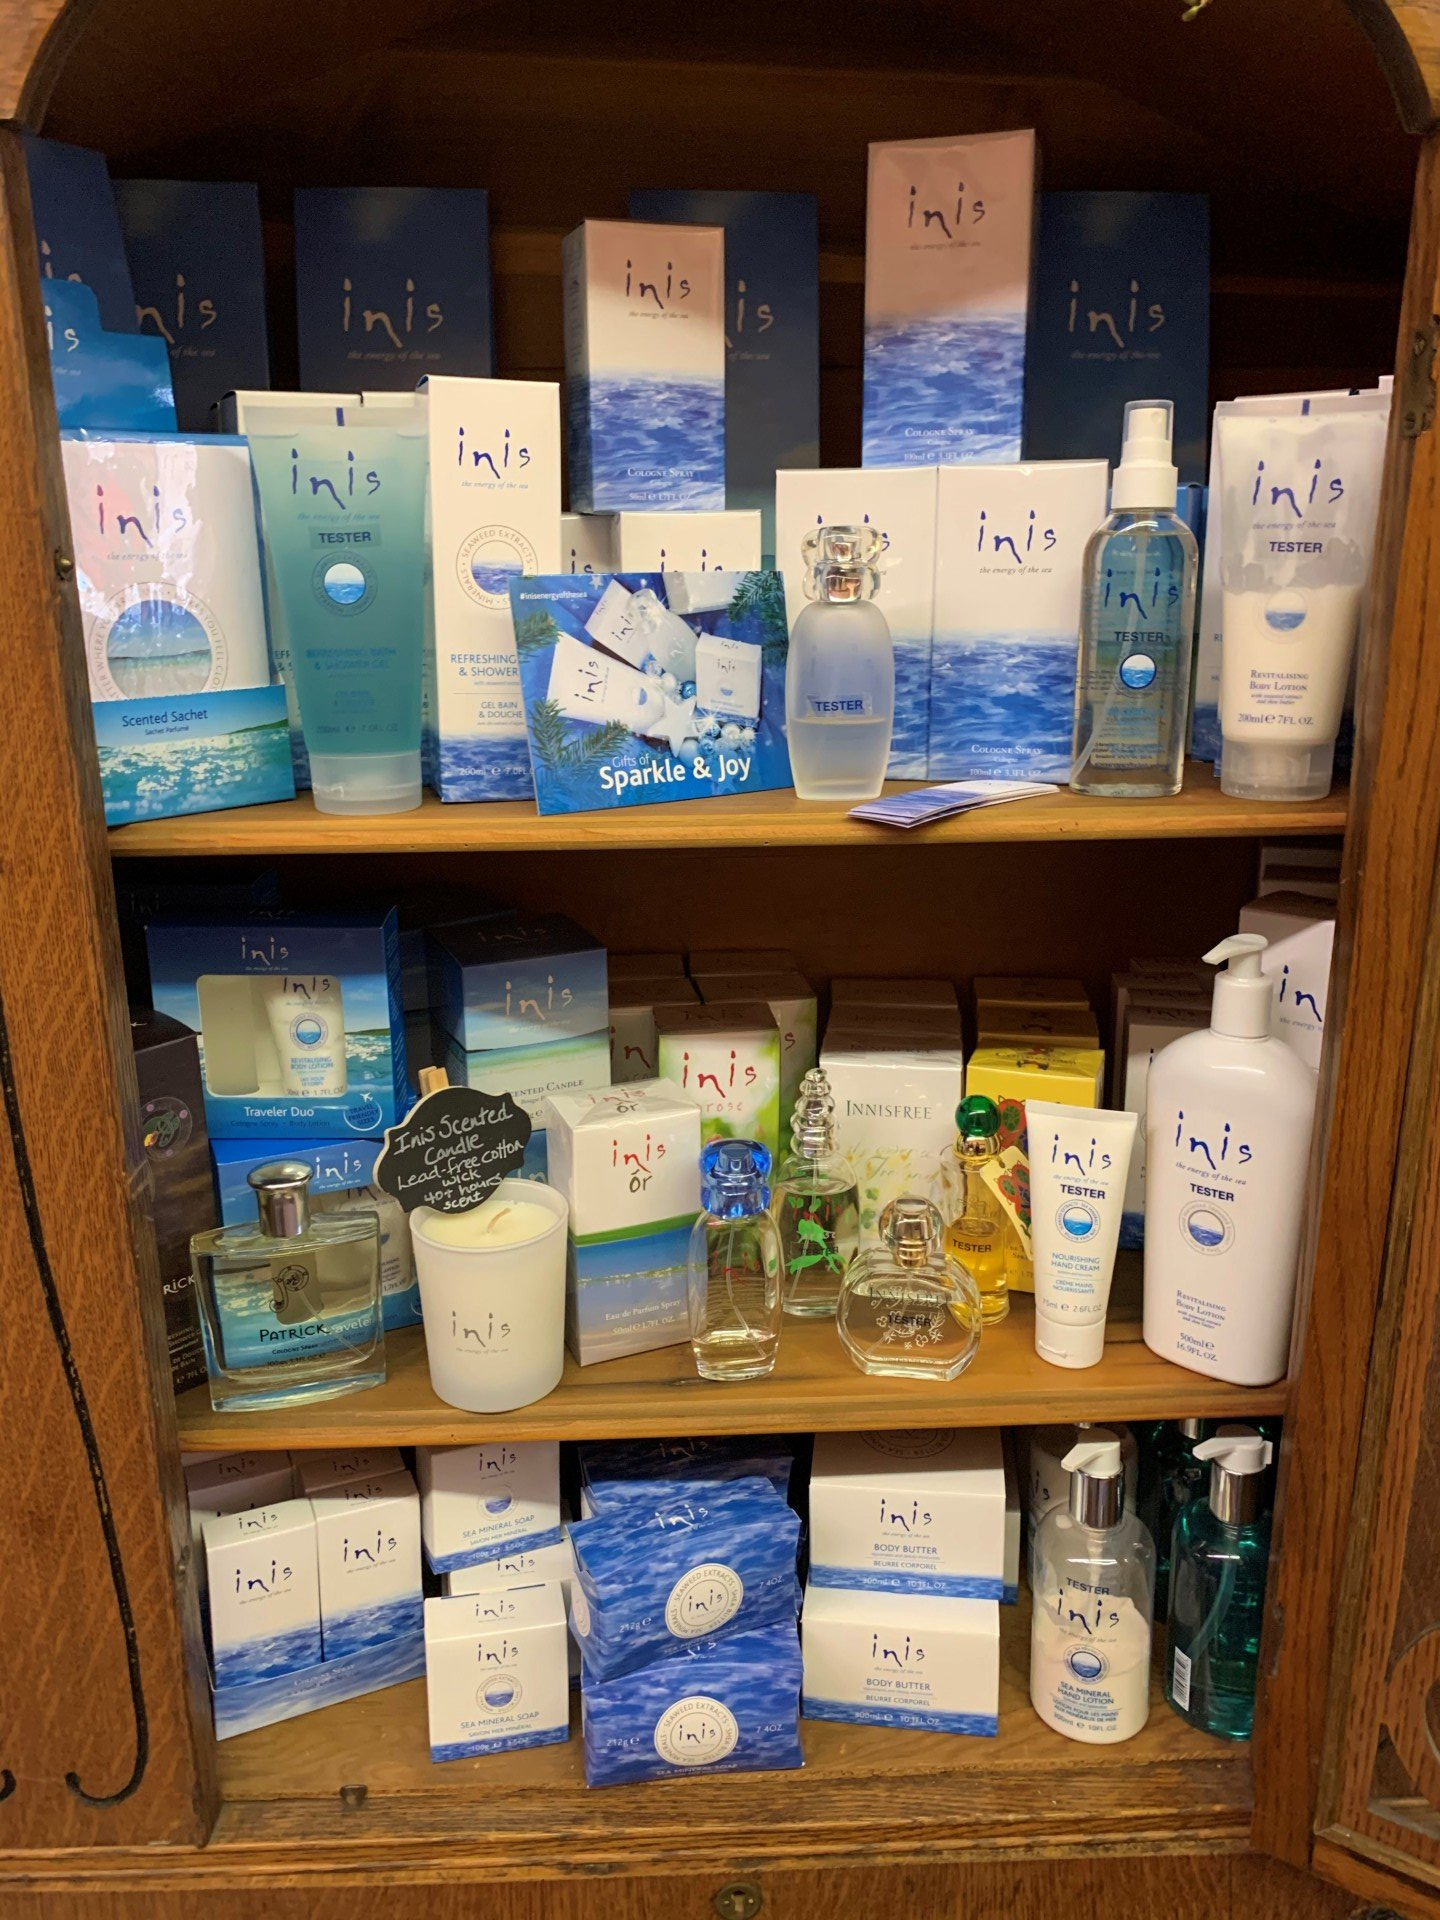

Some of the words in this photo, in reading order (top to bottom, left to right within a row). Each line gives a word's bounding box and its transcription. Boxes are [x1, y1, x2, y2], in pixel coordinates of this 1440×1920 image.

[908, 182, 985, 239] inis
[625, 259, 691, 309] inis
[343, 277, 443, 347] inis
[1067, 279, 1165, 349] inis
[458, 427, 531, 479] inis
[291, 448, 380, 510] inis
[1252, 459, 1344, 518] inis
[96, 484, 188, 549] inis
[1252, 520, 1265, 530] the
[1266, 521, 1294, 531] energy
[1297, 520, 1305, 530] of
[1307, 520, 1322, 529] the
[1323, 521, 1337, 529] sea
[318, 531, 371, 543] TESTER
[978, 509, 1056, 564] inis
[1269, 541, 1323, 553] TESTER
[980, 566, 991, 574] the
[992, 567, 1015, 575] energy
[1018, 565, 1026, 575] of
[1104, 567, 1179, 620] inis
[1114, 631, 1164, 643] TESTER
[450, 654, 517, 664] REFRESHING
[458, 666, 467, 676] &
[471, 666, 519, 677] SHOWER
[574, 660, 603, 702] inis
[1250, 669, 1309, 680] REVITALISING
[1274, 681, 1308, 691] LOTION
[478, 710, 485, 718] &
[487, 710, 523, 718] DOUCHE
[480, 701, 495, 709] GEL
[498, 701, 518, 709] BAIN
[815, 699, 864, 713] TESTER
[122, 711, 168, 727] Scented
[171, 709, 208, 723] Sachet
[1277, 714, 1296, 725] 7FL
[612, 755, 637, 768] Gifts
[639, 753, 651, 765] of
[599, 758, 686, 795] Sparkle
[693, 756, 712, 779] &
[718, 754, 751, 783] Joy
[241, 936, 288, 966] inis
[505, 974, 573, 1021] inis
[682, 1050, 757, 1099] inis
[244, 1106, 288, 1117] Traveler
[290, 1106, 315, 1117] Duo
[846, 1099, 932, 1120] INNISFREE
[394, 1125, 436, 1155] Inis
[438, 1101, 513, 1138] Scented
[424, 1133, 484, 1165] Candle
[1175, 1110, 1252, 1170] inis
[613, 1133, 666, 1174] inis
[1052, 1133, 1112, 1176] inis
[315, 1151, 362, 1181] inis
[398, 1156, 480, 1190] Lead-free
[1175, 1161, 1186, 1170] the
[1187, 1166, 1210, 1178] energy
[1211, 1172, 1220, 1181] of
[1221, 1174, 1233, 1182] the
[424, 1189, 454, 1204] 40+
[459, 1173, 503, 1196] hours
[629, 1168, 653, 1193] ór
[1060, 1183, 1105, 1199] TESTER
[443, 1190, 483, 1210] scent
[1189, 1182, 1235, 1202] TESTER
[952, 1238, 992, 1254] TESTER
[1051, 1260, 1073, 1270] HAND
[1074, 1262, 1100, 1272] CREAM
[1052, 1252, 1100, 1265] NOURISHING
[605, 1312, 622, 1321] Eau
[622, 1310, 631, 1318] de
[632, 1304, 660, 1317] Parfum
[661, 1299, 681, 1311] Spray
[1176, 1289, 1227, 1312] REVITALISING
[887, 1314, 931, 1327] TESTER
[1196, 1306, 1225, 1321] LOTION
[452, 1311, 511, 1348] inis
[1180, 1332, 1204, 1348] 500ml
[479, 1447, 517, 1472] inis
[344, 1484, 383, 1500] inis
[238, 1511, 278, 1529] inis
[654, 1503, 709, 1529] inis
[880, 1498, 932, 1532] inis
[462, 1529, 477, 1539] SEA
[478, 1521, 513, 1534] MINERAL
[514, 1514, 535, 1526] SOAP
[344, 1529, 397, 1563] inis
[874, 1543, 900, 1553] BODY
[902, 1545, 937, 1555] BUTTER
[496, 1555, 535, 1571] inis
[873, 1560, 899, 1568] BEURRE
[900, 1561, 937, 1570] CORPOREL
[236, 1559, 293, 1593] inis
[673, 1572, 701, 1603] SEAWEED
[703, 1569, 735, 1587] EXTRACTS
[1066, 1577, 1110, 1596] TESTER
[475, 1600, 516, 1618] inis
[688, 1589, 723, 1612] inis
[1057, 1588, 1120, 1635] inis
[619, 1621, 641, 1634] 212g
[477, 1640, 519, 1664] inis
[872, 1633, 925, 1668] inis
[866, 1678, 893, 1688] BODY
[895, 1680, 931, 1691] BUTTER
[1060, 1680, 1074, 1692] SEA
[1076, 1686, 1111, 1699] MINERAL
[865, 1694, 892, 1703] BEURRE
[893, 1697, 931, 1707] CORPOREL
[1057, 1686, 1081, 1701] HAND
[1083, 1695, 1114, 1706] LOTION
[460, 1721, 476, 1729] SEA
[478, 1715, 515, 1727] MINERAL
[517, 1711, 540, 1721] SOAP
[664, 1703, 694, 1728] SEAWEED
[695, 1702, 729, 1724] EXTRACTS
[606, 1737, 629, 1747] 212g
[678, 1722, 716, 1744] inis
